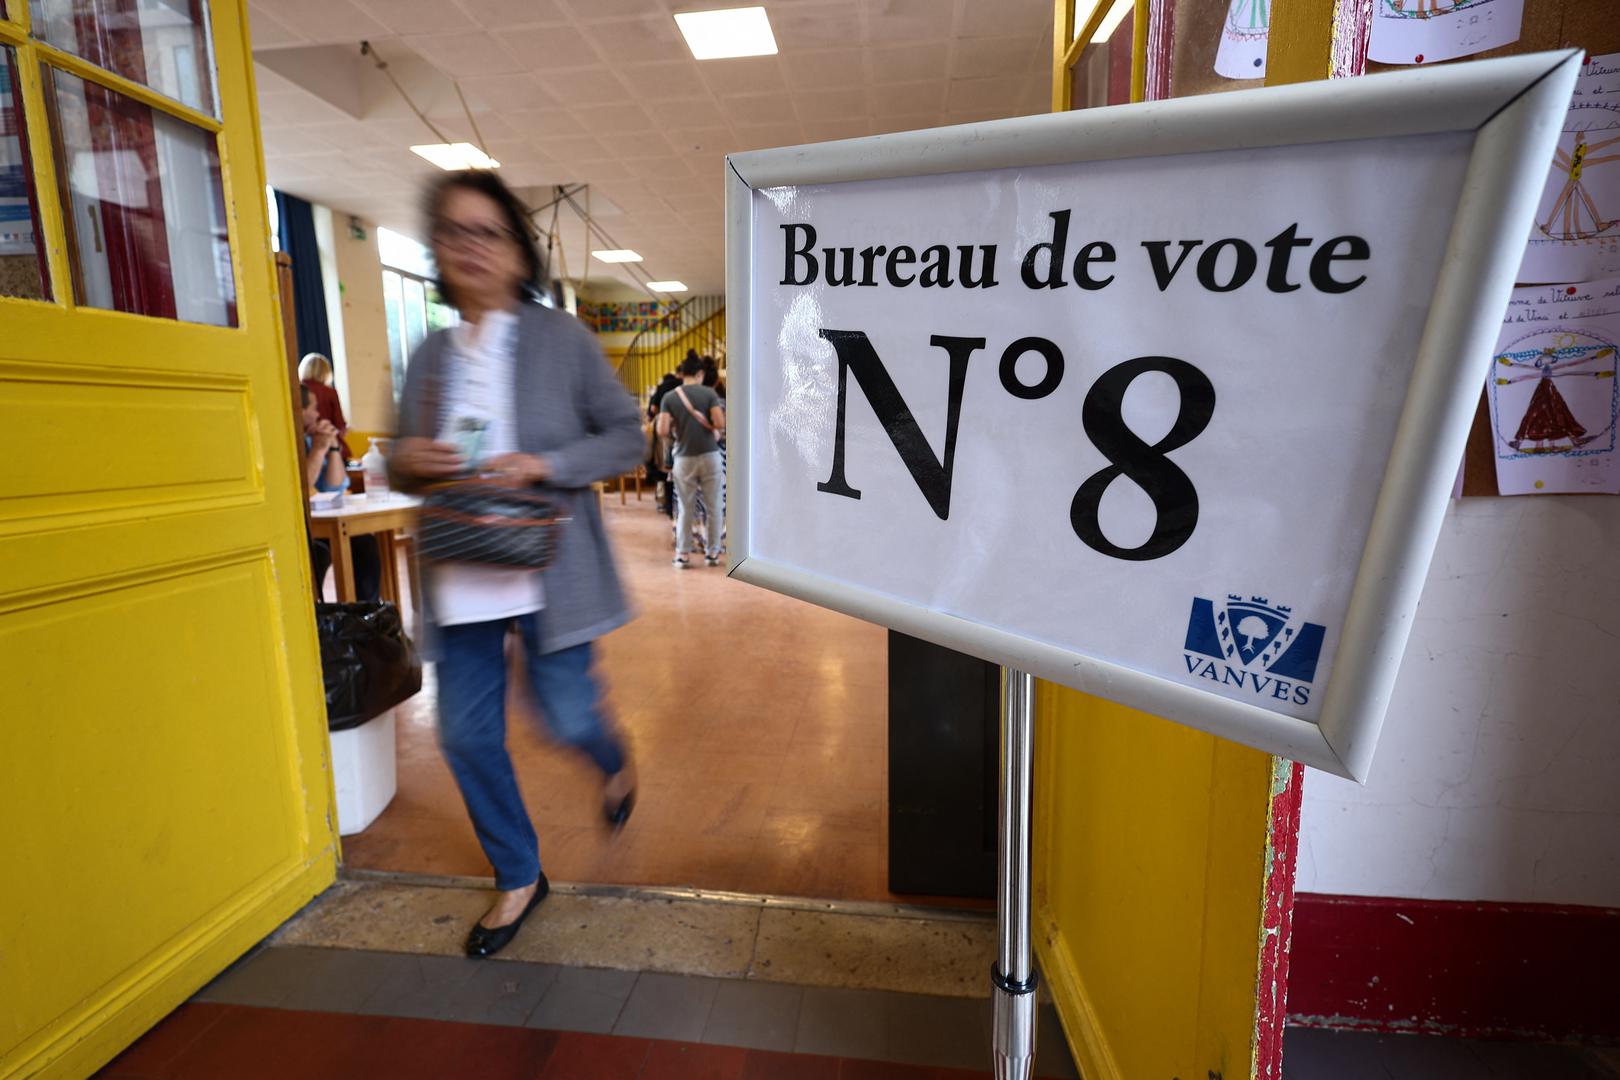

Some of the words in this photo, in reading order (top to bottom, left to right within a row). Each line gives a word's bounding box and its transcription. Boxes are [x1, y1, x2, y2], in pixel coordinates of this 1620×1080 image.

[779, 222, 999, 289] Bureau
[1020, 208, 1117, 291] de
[1140, 222, 1371, 295] vote
[1183, 653, 1312, 706] VANVES
